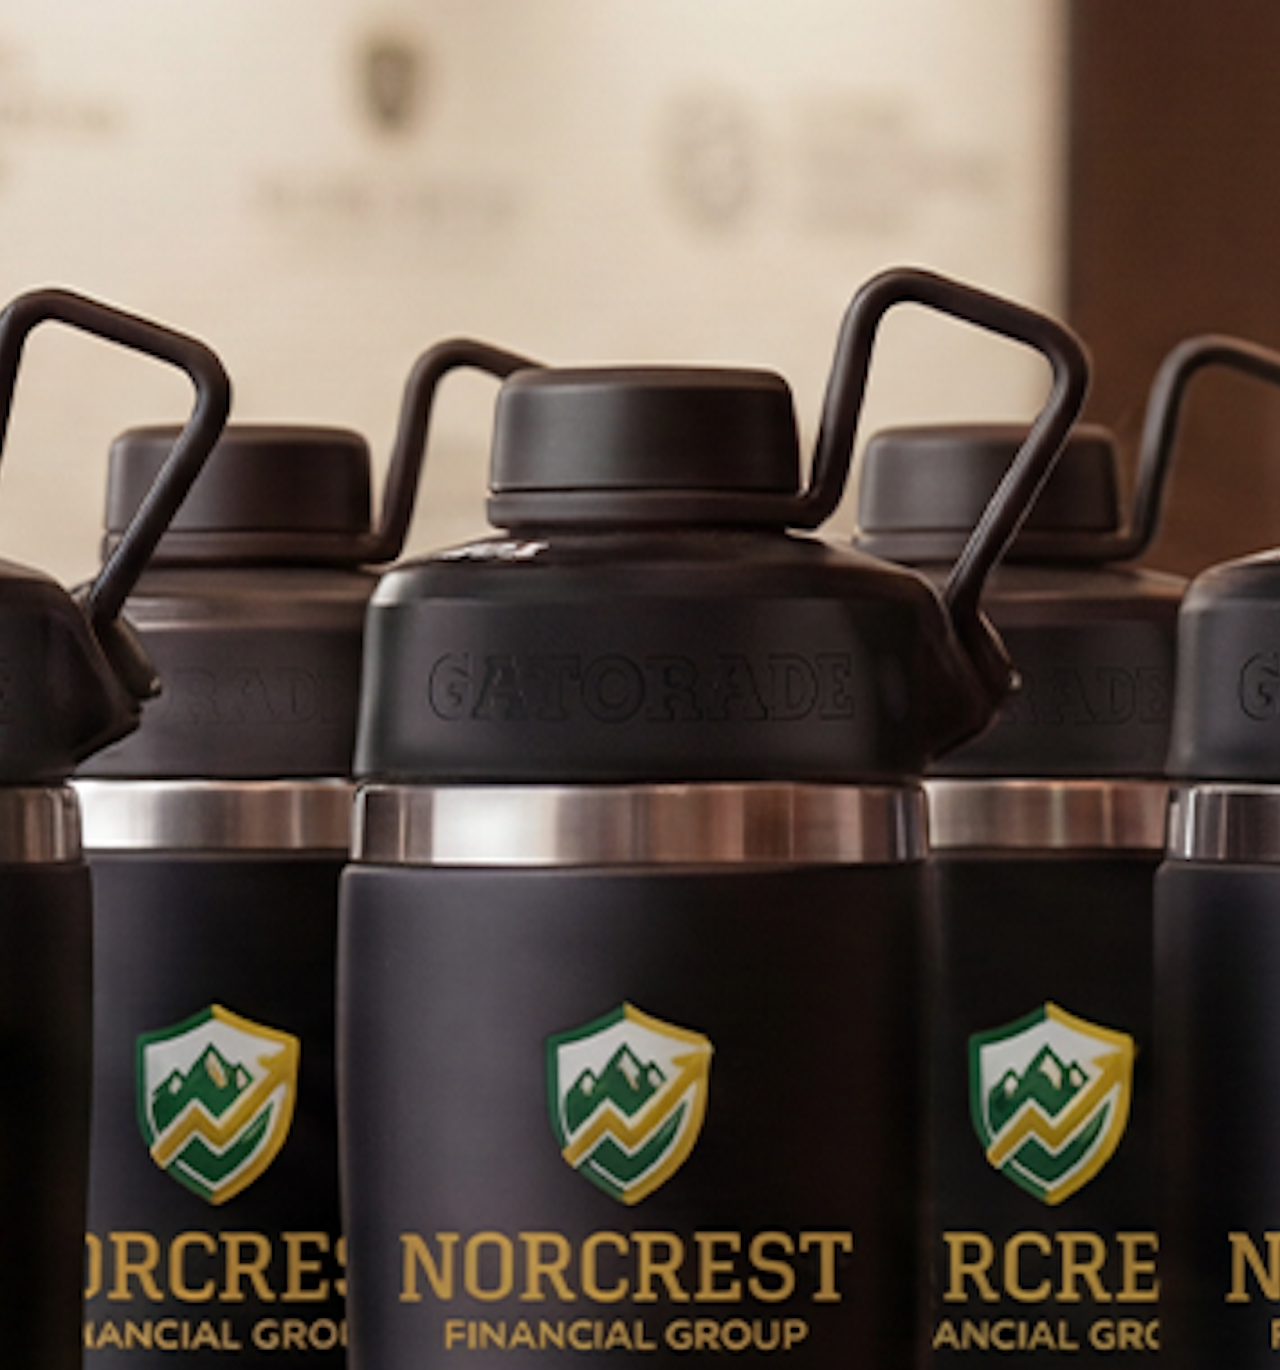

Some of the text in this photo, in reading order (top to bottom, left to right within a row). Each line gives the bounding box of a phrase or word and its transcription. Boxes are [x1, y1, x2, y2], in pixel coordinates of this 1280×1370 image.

[427, 652, 854, 724] GATORADE
[84, 1230, 348, 1302] RCRE
[399, 1230, 853, 1302] NORCREST
[942, 1230, 1160, 1303] RCRE
[84, 1317, 348, 1351] ANCIAL GRO
[444, 1318, 809, 1351] FINANCIAL GROUP
[932, 1318, 1080, 1351] ANCIAL
